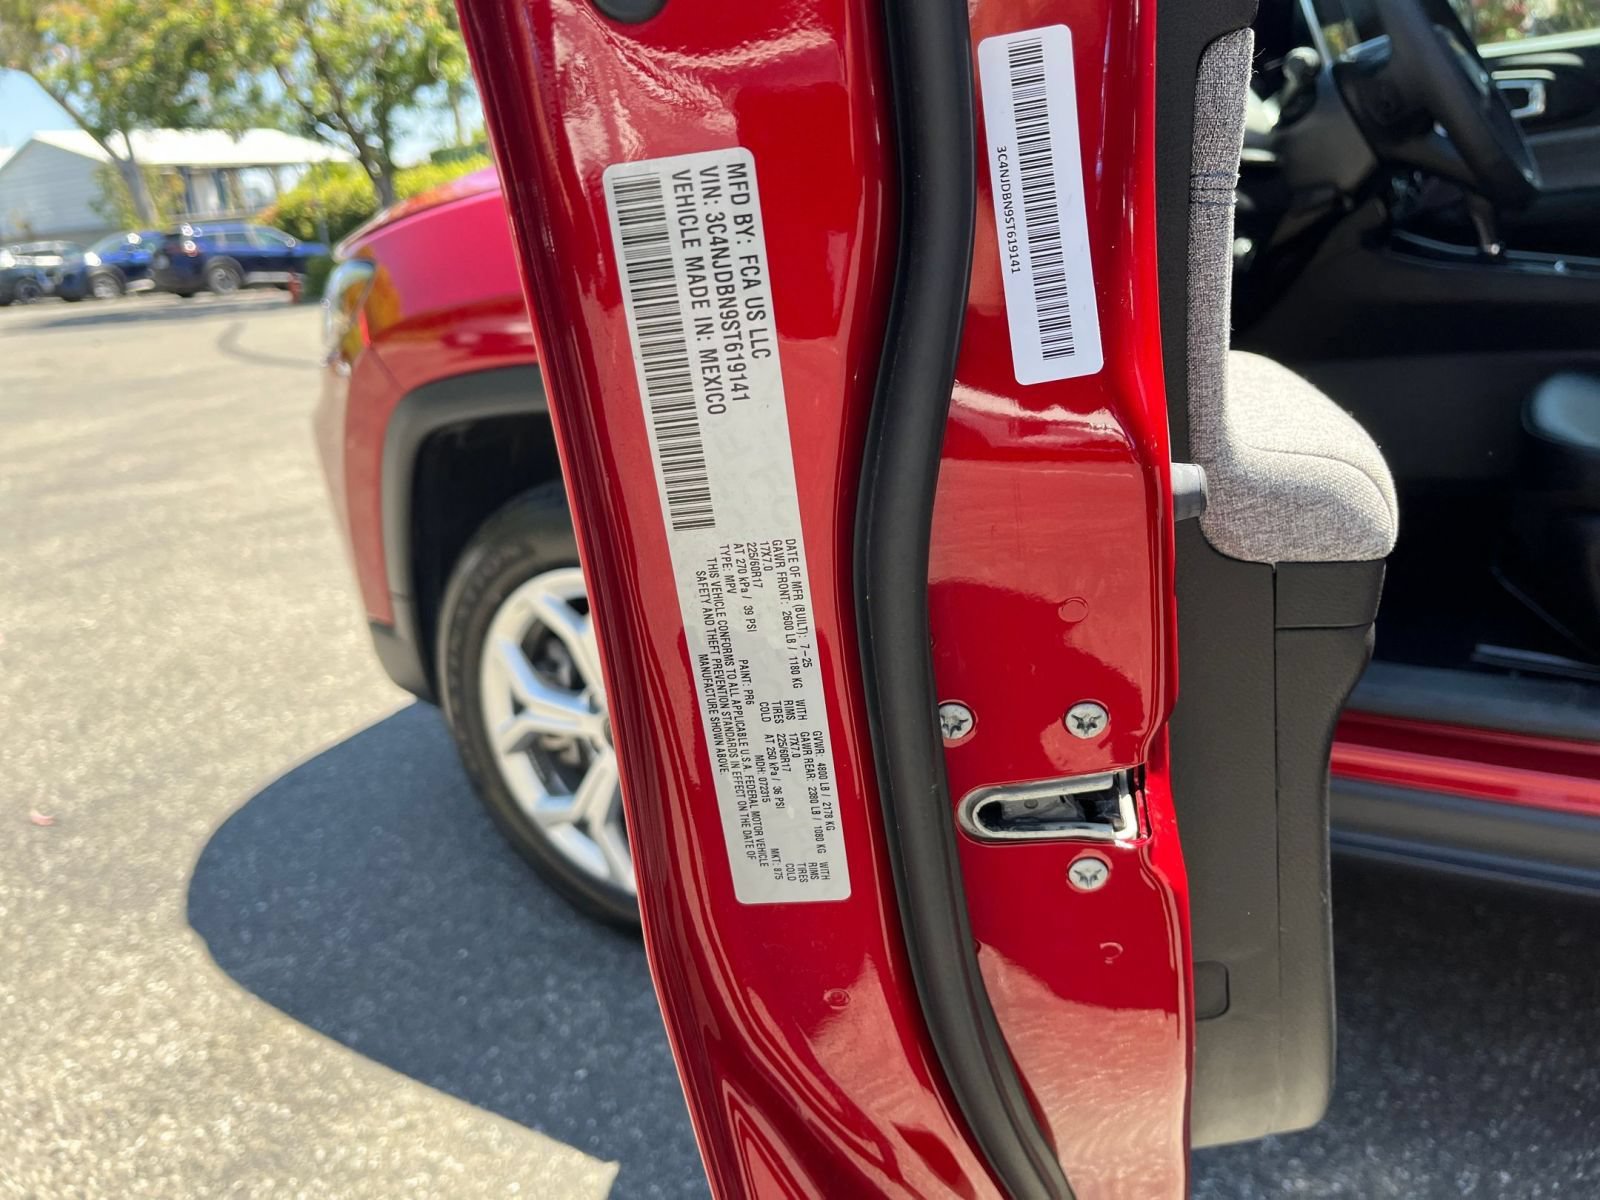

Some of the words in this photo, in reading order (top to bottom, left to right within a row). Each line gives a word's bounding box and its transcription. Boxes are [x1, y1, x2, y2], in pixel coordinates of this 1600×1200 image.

[698, 165, 722, 205] VIN:
[725, 162, 750, 205] MFD
[671, 168, 701, 249] VEHICLE
[996, 145, 1020, 274] 3C4NJDBN9ST619141
[732, 213, 755, 244] BY:
[683, 255, 710, 309] MADE
[738, 254, 761, 290] FCA
[704, 211, 750, 401] 3C4NJDBN9ST619141
[744, 296, 766, 321] US
[693, 316, 714, 341] IN:
[748, 327, 771, 359] LLC
[698, 348, 726, 415] MEXICO
[718, 543, 732, 571] TYPE:
[732, 543, 745, 554] AT
[771, 539, 785, 568] GAWR
[784, 538, 798, 563] DATE
[706, 556, 719, 578] THIS
[735, 558, 747, 574] 270
[788, 565, 800, 577] OF
[695, 570, 711, 604] SAFETY
[723, 574, 737, 594] MPV
[738, 576, 750, 593] kPa
[775, 571, 790, 604] FRONT:
[790, 580, 803, 600] MFR
[710, 580, 726, 617] VEHICLE
[743, 605, 754, 615] 39
[701, 607, 715, 626] AND
[745, 618, 757, 632] PSI
[781, 610, 794, 630] 2600
[791, 604, 808, 638] (BUILT):
[705, 628, 720, 655] THEFT
[745, 541, 763, 588] 225/60R17
[771, 700, 784, 724] TIRES
[759, 540, 773, 571] 17X7.0
[783, 699, 795, 720] RIMS
[784, 633, 796, 643] LB
[716, 619, 734, 666] CONFORMS
[788, 656, 800, 675] 1180
[799, 643, 812, 668] 7-25
[698, 653, 718, 714] MANUFACTURE
[711, 658, 729, 709] PREVENTION
[725, 668, 737, 680] TO
[738, 659, 751, 686] PAINT:
[791, 678, 802, 688] KG
[727, 682, 739, 697] ALL
[743, 689, 754, 705] PR6
[758, 701, 771, 722] COLD
[794, 698, 807, 720] WITH
[709, 716, 724, 745] SHOWN
[720, 710, 738, 758] STANDARDS
[730, 699, 748, 746] APPLICABLE
[763, 734, 774, 743] AT
[799, 731, 812, 755] GAWR
[812, 730, 824, 757] GVWR:
[715, 747, 729, 775] ABOVE.
[730, 760, 740, 768] IN
[739, 748, 752, 772] U.S.A.
[754, 754, 766, 774] MDH:
[765, 746, 776, 760] 250
[768, 762, 778, 776] kPa
[803, 757, 815, 781] REAR:
[816, 762, 827, 779] 4800
[731, 771, 745, 798] EFFECT
[744, 774, 758, 809] FEDERAL
[757, 776, 771, 803] 072315
[772, 785, 782, 794] 36
[807, 786, 819, 803] 2380
[819, 782, 829, 791] LB
[736, 800, 747, 811] ON
[774, 797, 784, 809] PSI
[776, 733, 791, 772] 225/60R17
[796, 862, 808, 883] TIRES
[788, 732, 800, 758] 17X7.0
[807, 862, 819, 879] RIMS
[810, 806, 820, 815] LB
[821, 801, 833, 818] 2178
[739, 813, 750, 828] THE
[750, 810, 763, 836] MOTOR
[824, 820, 834, 831] KG
[742, 829, 754, 848] DATE
[813, 825, 824, 841] 1080
[745, 850, 756, 860] OF
[755, 838, 768, 867] VEHICLE
[770, 847, 781, 865] MKT:
[816, 843, 826, 853] KG
[772, 867, 783, 880] 875
[784, 862, 796, 881] COLD
[818, 861, 830, 880] WITH
